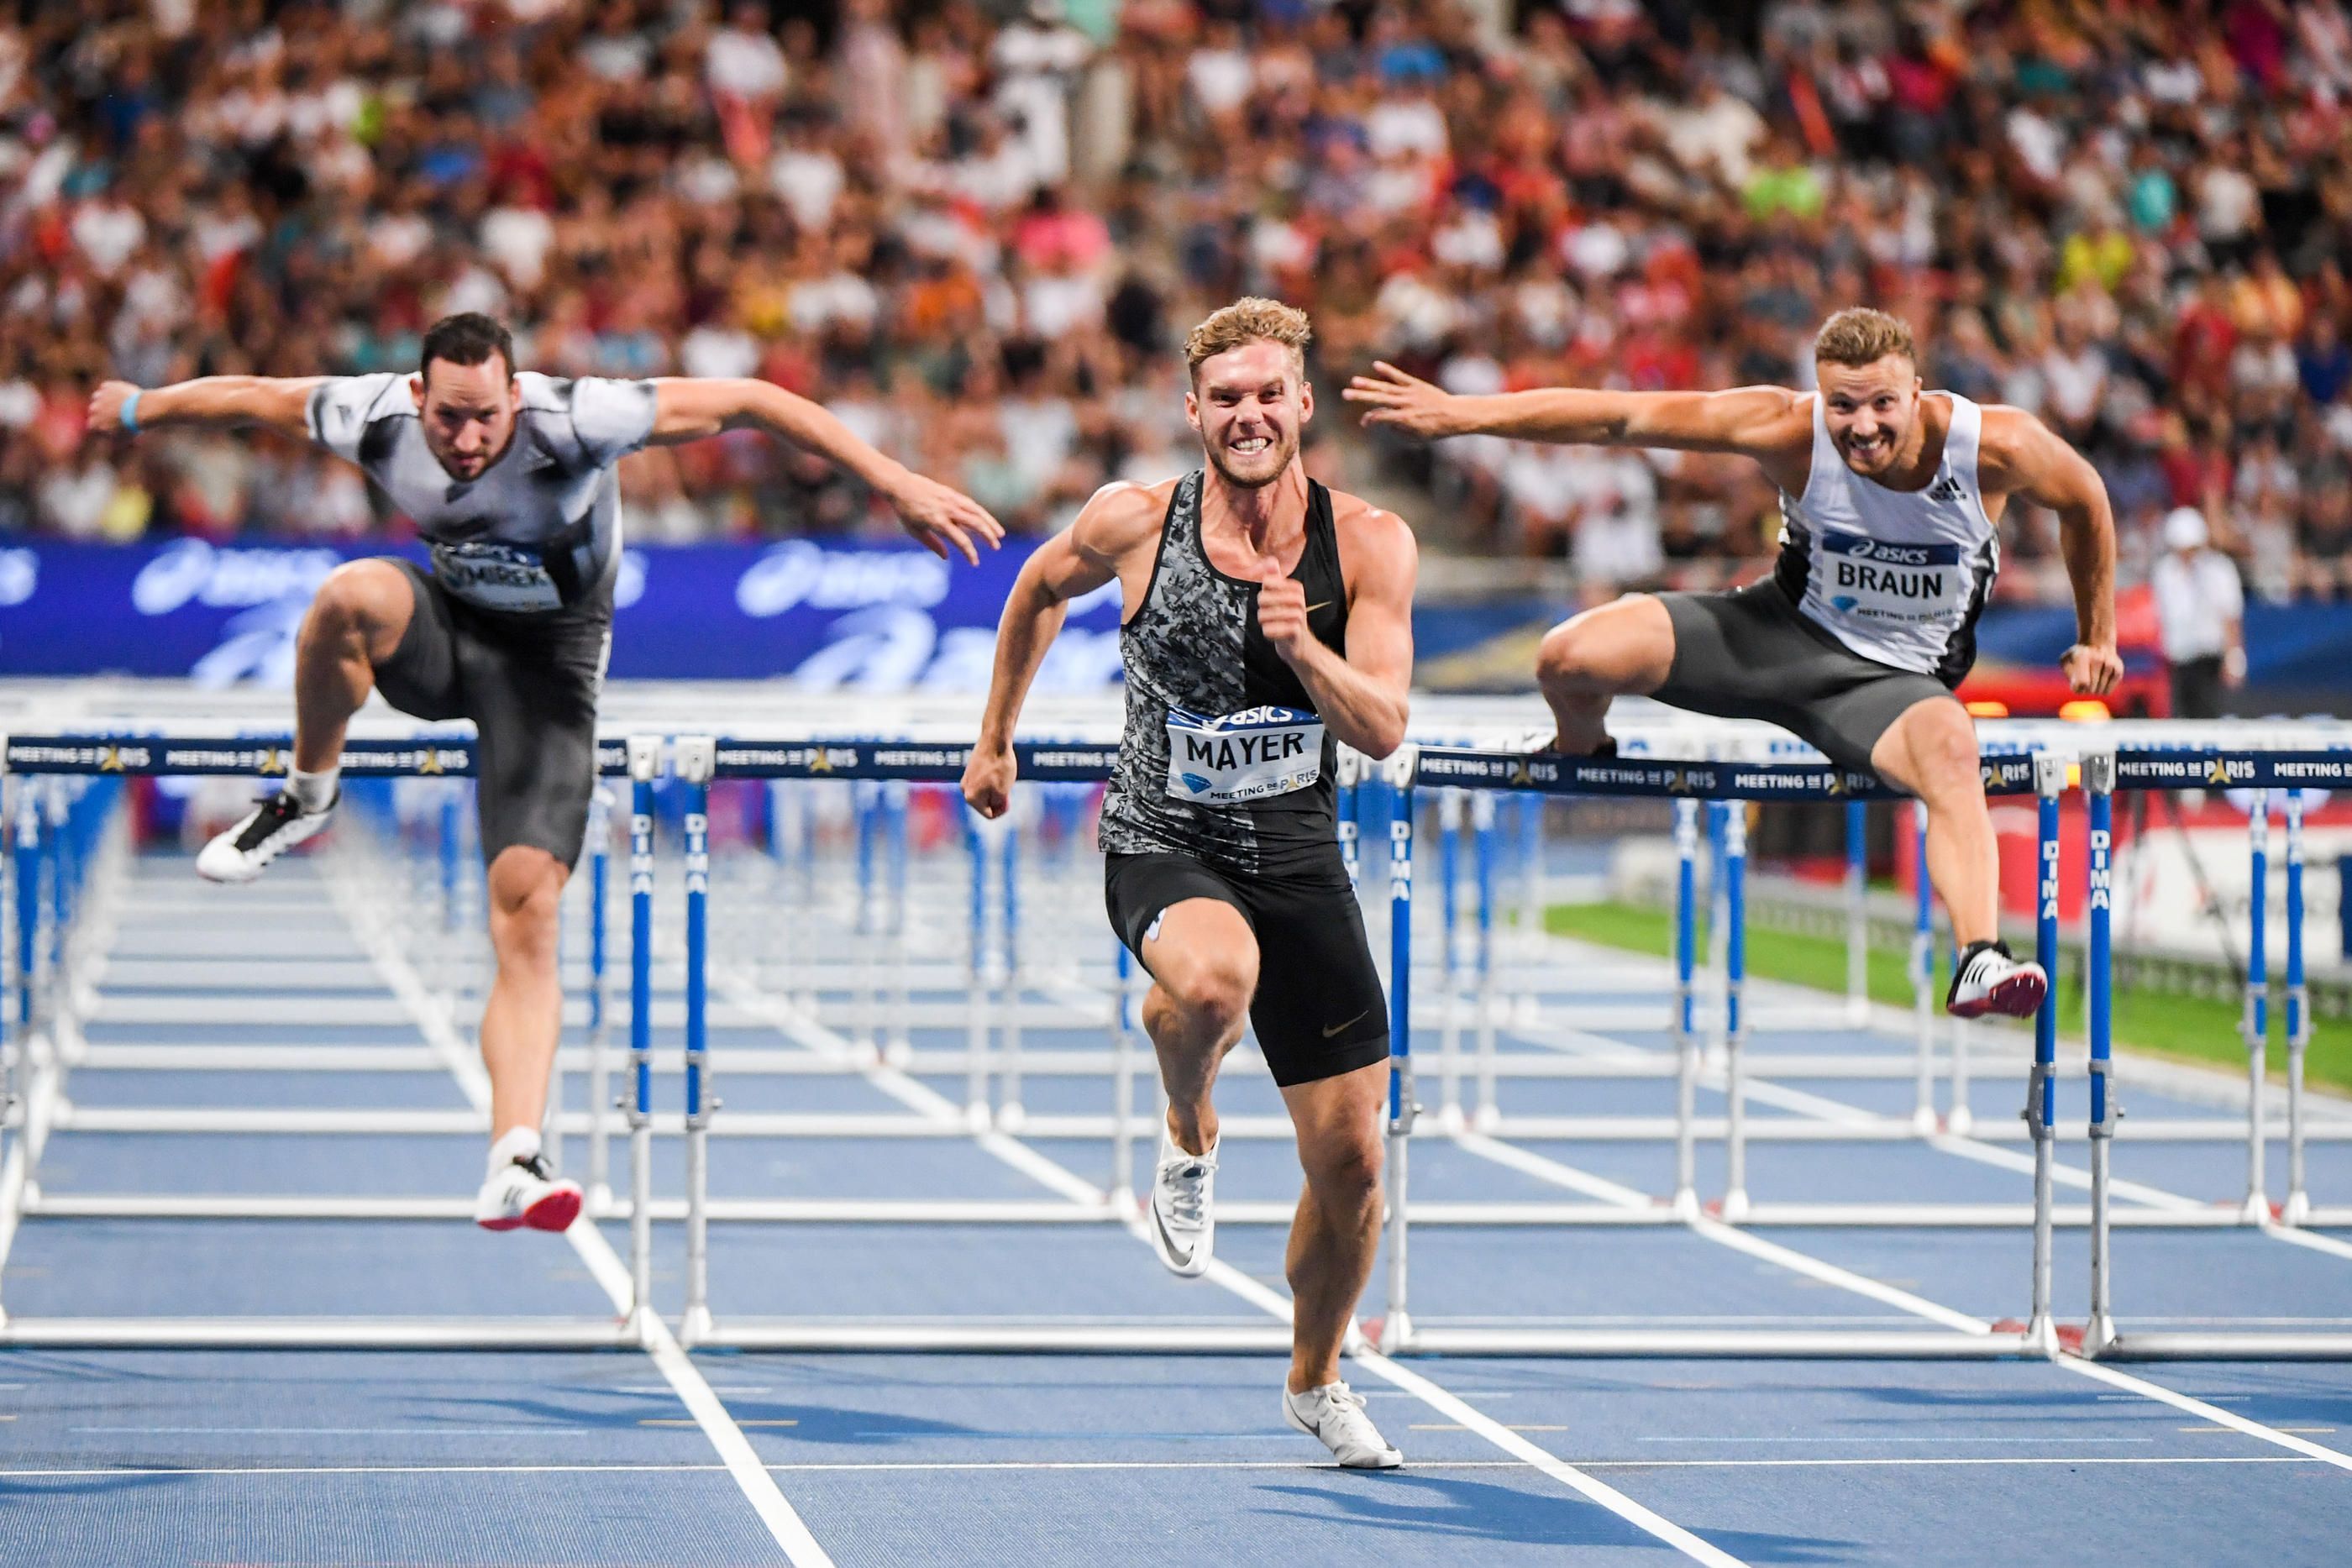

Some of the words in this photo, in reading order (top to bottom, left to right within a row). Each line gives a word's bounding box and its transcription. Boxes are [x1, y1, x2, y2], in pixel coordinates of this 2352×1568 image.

[1874, 545, 1929, 564] asics
[1838, 561, 1942, 599] BRAUN
[1230, 705, 1293, 726] asics
[8, 746, 77, 763] MEETING
[96, 742, 150, 771] PARIS
[166, 750, 237, 767] MEETING
[339, 752, 396, 768] EETING
[414, 744, 469, 774] PARIS
[716, 749, 785, 765] MEETING
[804, 746, 858, 772] PARIS
[874, 751, 944, 766] MEETING
[1033, 752, 1103, 767] MEETING
[1186, 732, 1305, 771] MAYER
[1420, 758, 1488, 776] MEETING
[1506, 757, 1558, 786] PARIS
[1577, 768, 1644, 784] MEETING
[1662, 766, 1716, 793] PARIS
[1735, 774, 1804, 789] MEETING
[1981, 763, 2029, 788] PARIS
[2118, 762, 2185, 776] MEETING
[2187, 763, 2202, 777] DE
[2204, 758, 2255, 784] PARIS
[2274, 763, 2342, 777] MEETING
[1210, 784, 1264, 799] MEETING
[1267, 782, 1278, 790] DE
[1280, 769, 1317, 790] PARIS
[632, 813, 653, 894] DIMA
[685, 813, 708, 894] DIMA
[1390, 821, 1411, 900] DIMA
[2091, 830, 2110, 910] DIMA
